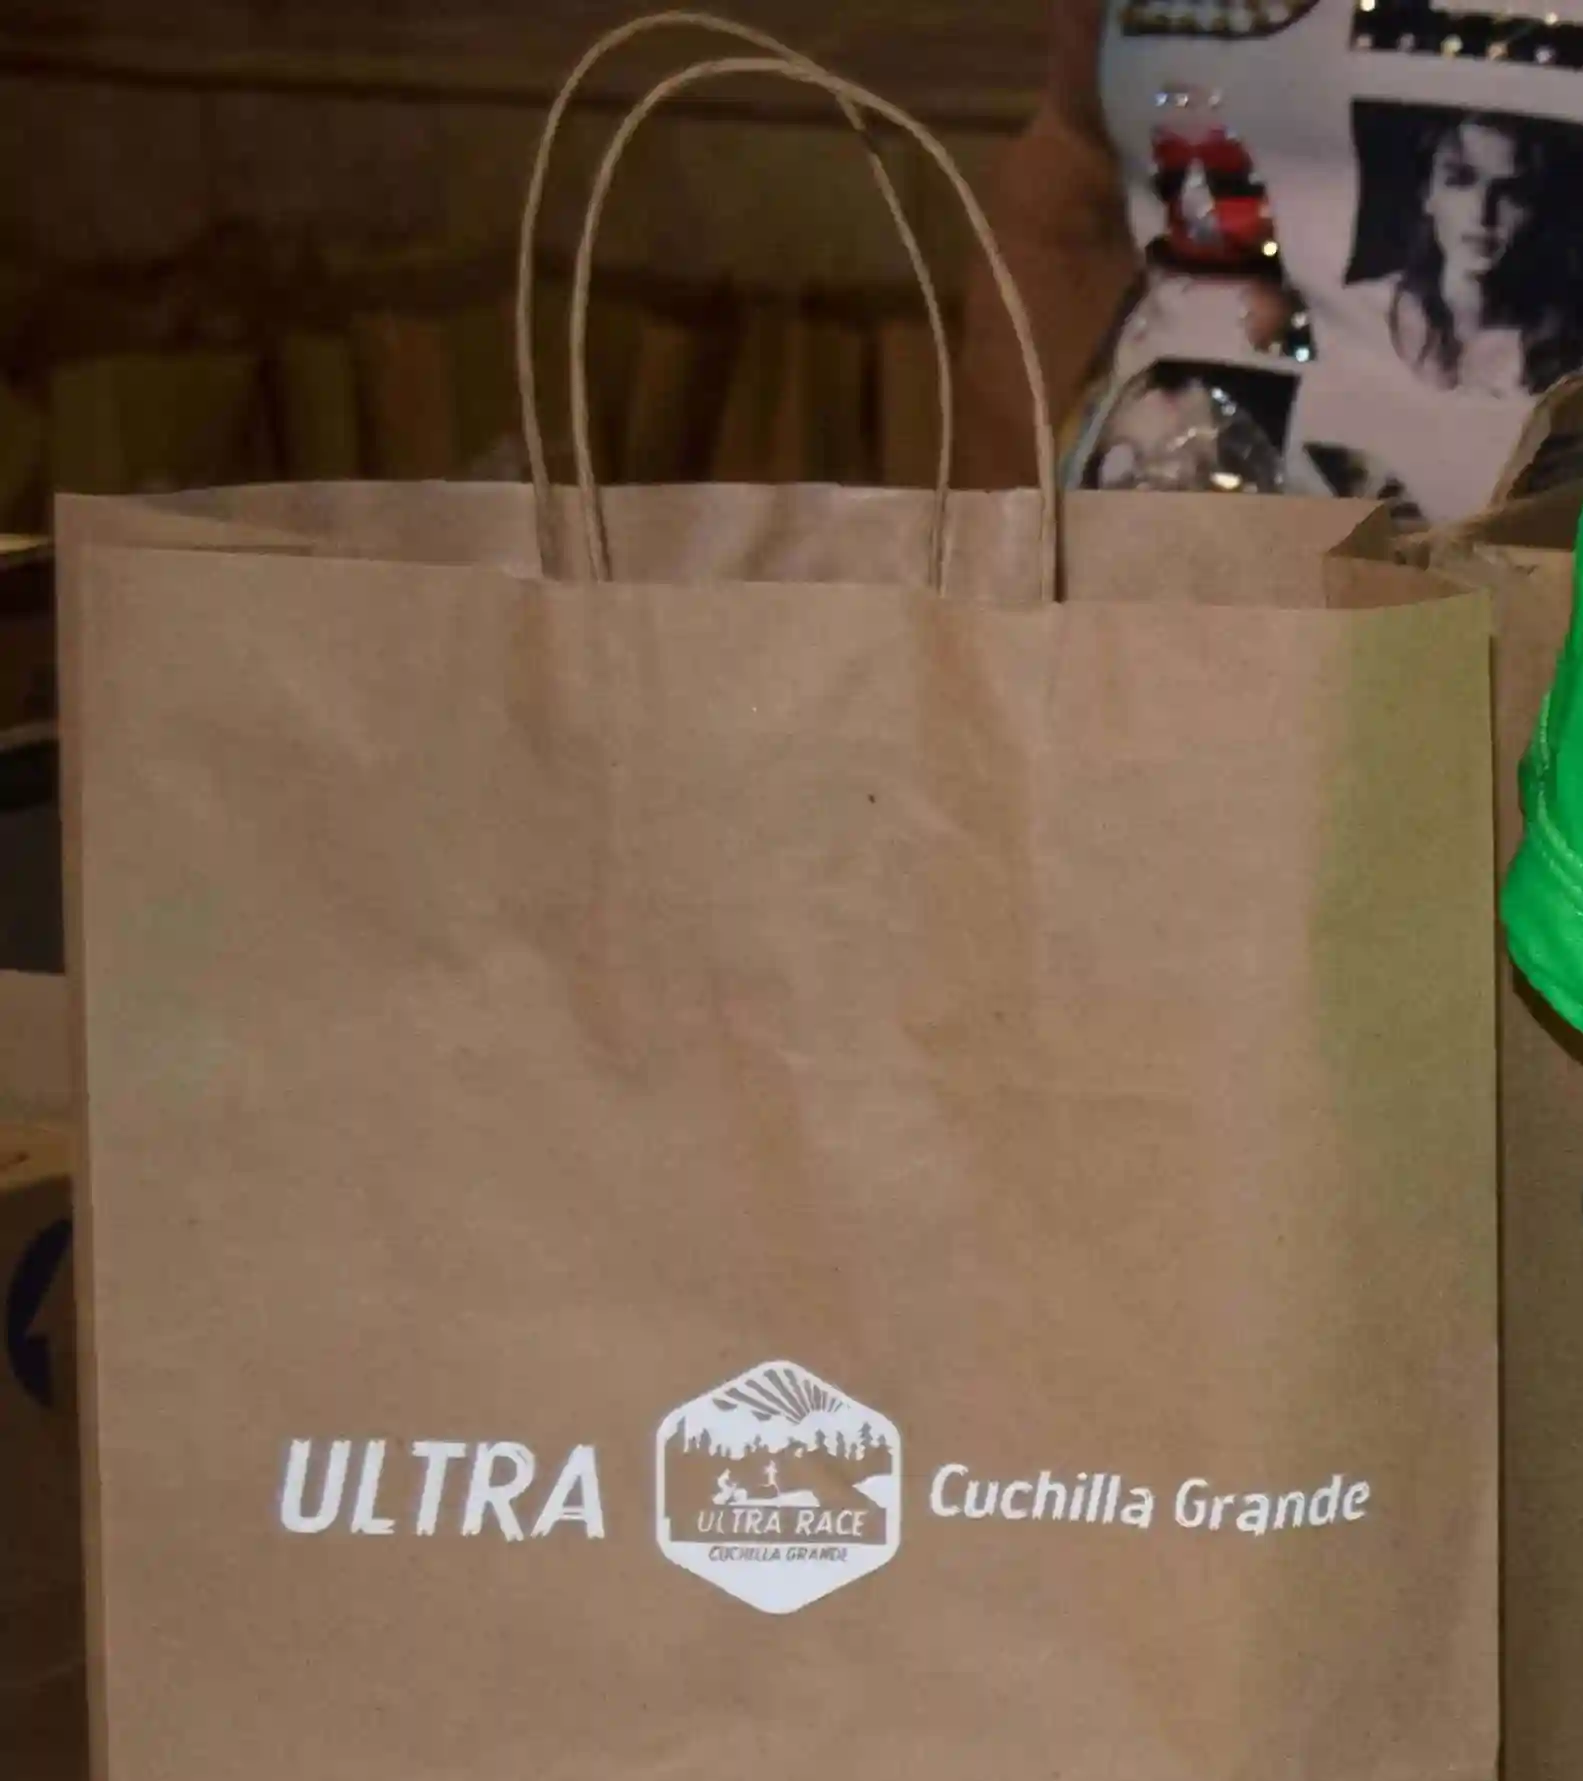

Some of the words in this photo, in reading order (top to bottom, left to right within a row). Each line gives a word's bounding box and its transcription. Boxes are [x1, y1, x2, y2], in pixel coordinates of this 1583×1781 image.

[277, 1437, 607, 1543] ULTRA
[928, 1463, 1153, 1530] Cuchilla
[1174, 1472, 1372, 1537] Grande
[697, 1508, 782, 1535] ULTRA
[794, 1509, 869, 1537] RACE
[708, 1545, 782, 1563] CUCHILLA
[785, 1546, 849, 1563] GRANDE
